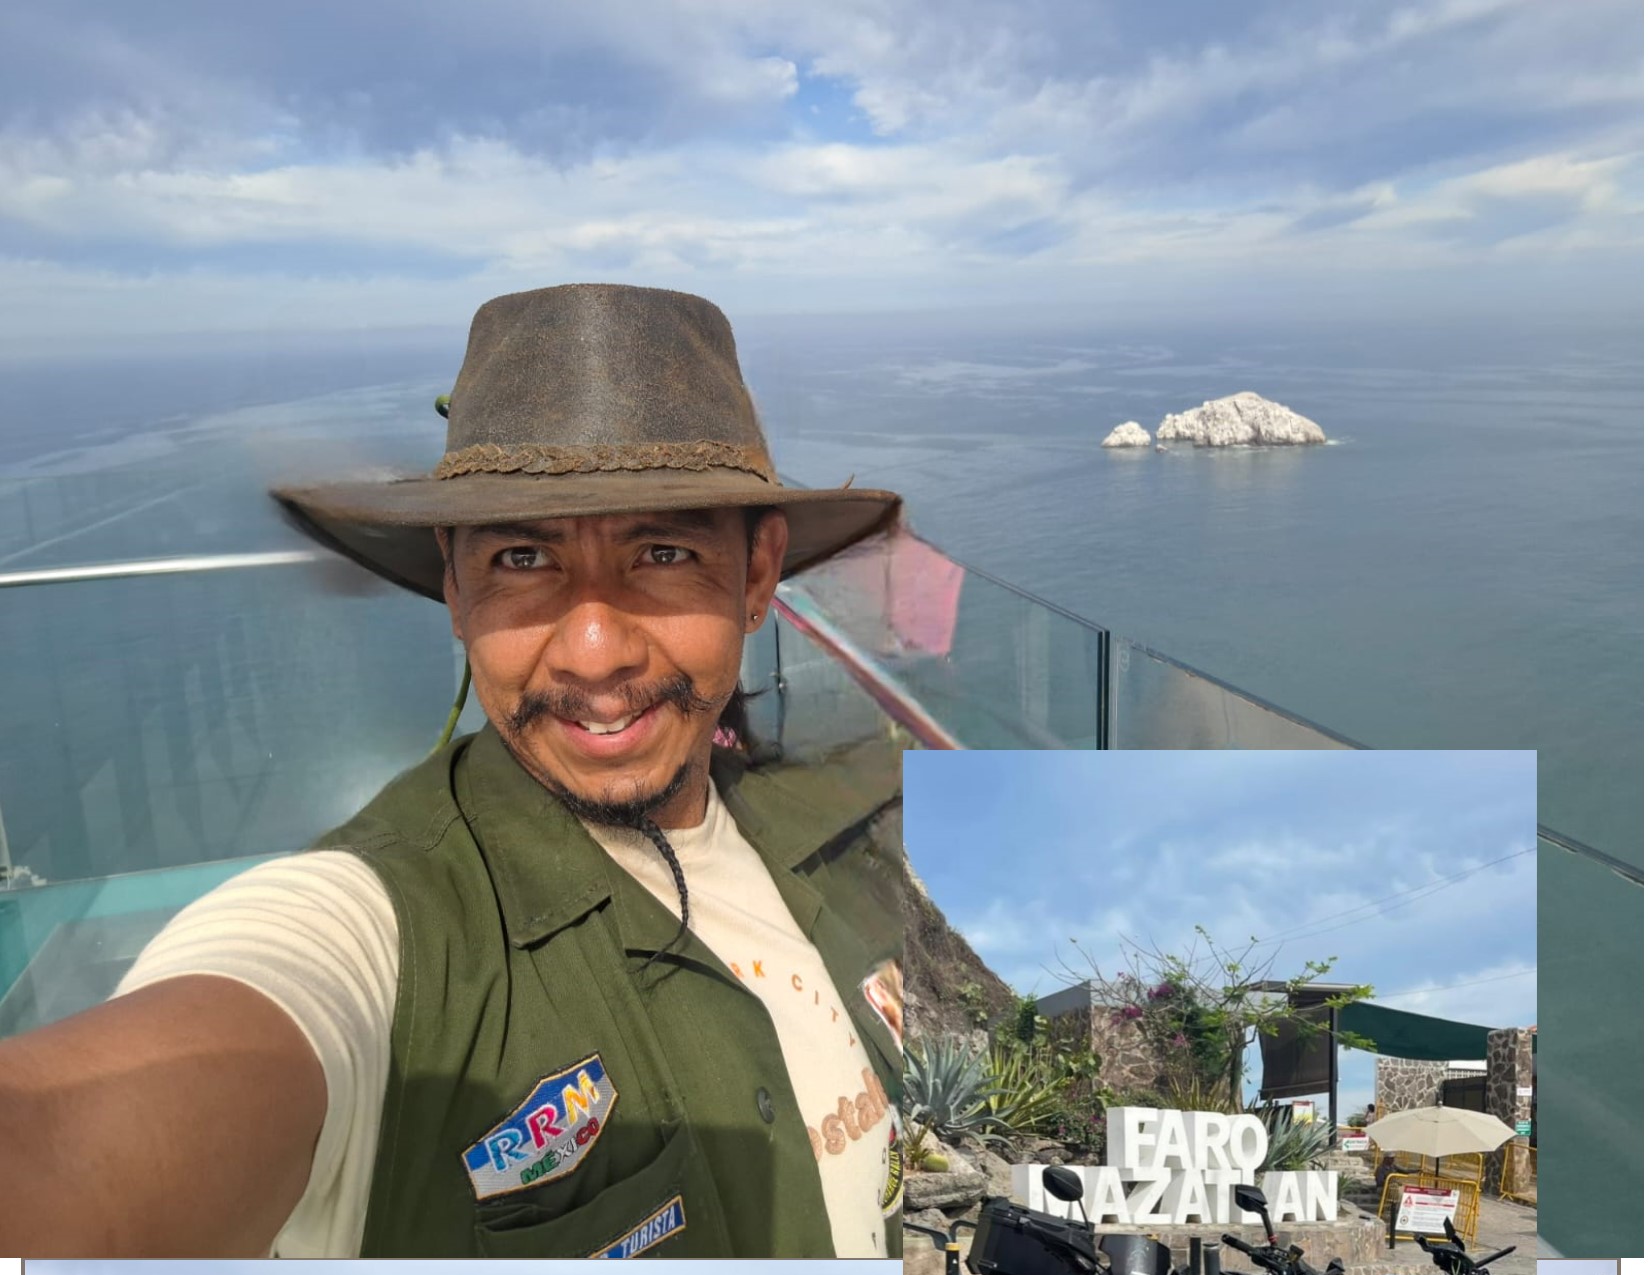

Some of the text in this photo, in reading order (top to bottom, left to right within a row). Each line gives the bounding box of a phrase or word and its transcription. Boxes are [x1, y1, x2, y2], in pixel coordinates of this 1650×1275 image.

[484, 1069, 601, 1174] RRM
[519, 1115, 600, 1185] MÉXICO
[1107, 1106, 1269, 1171] FARO
[620, 1205, 676, 1259] TURISTA
